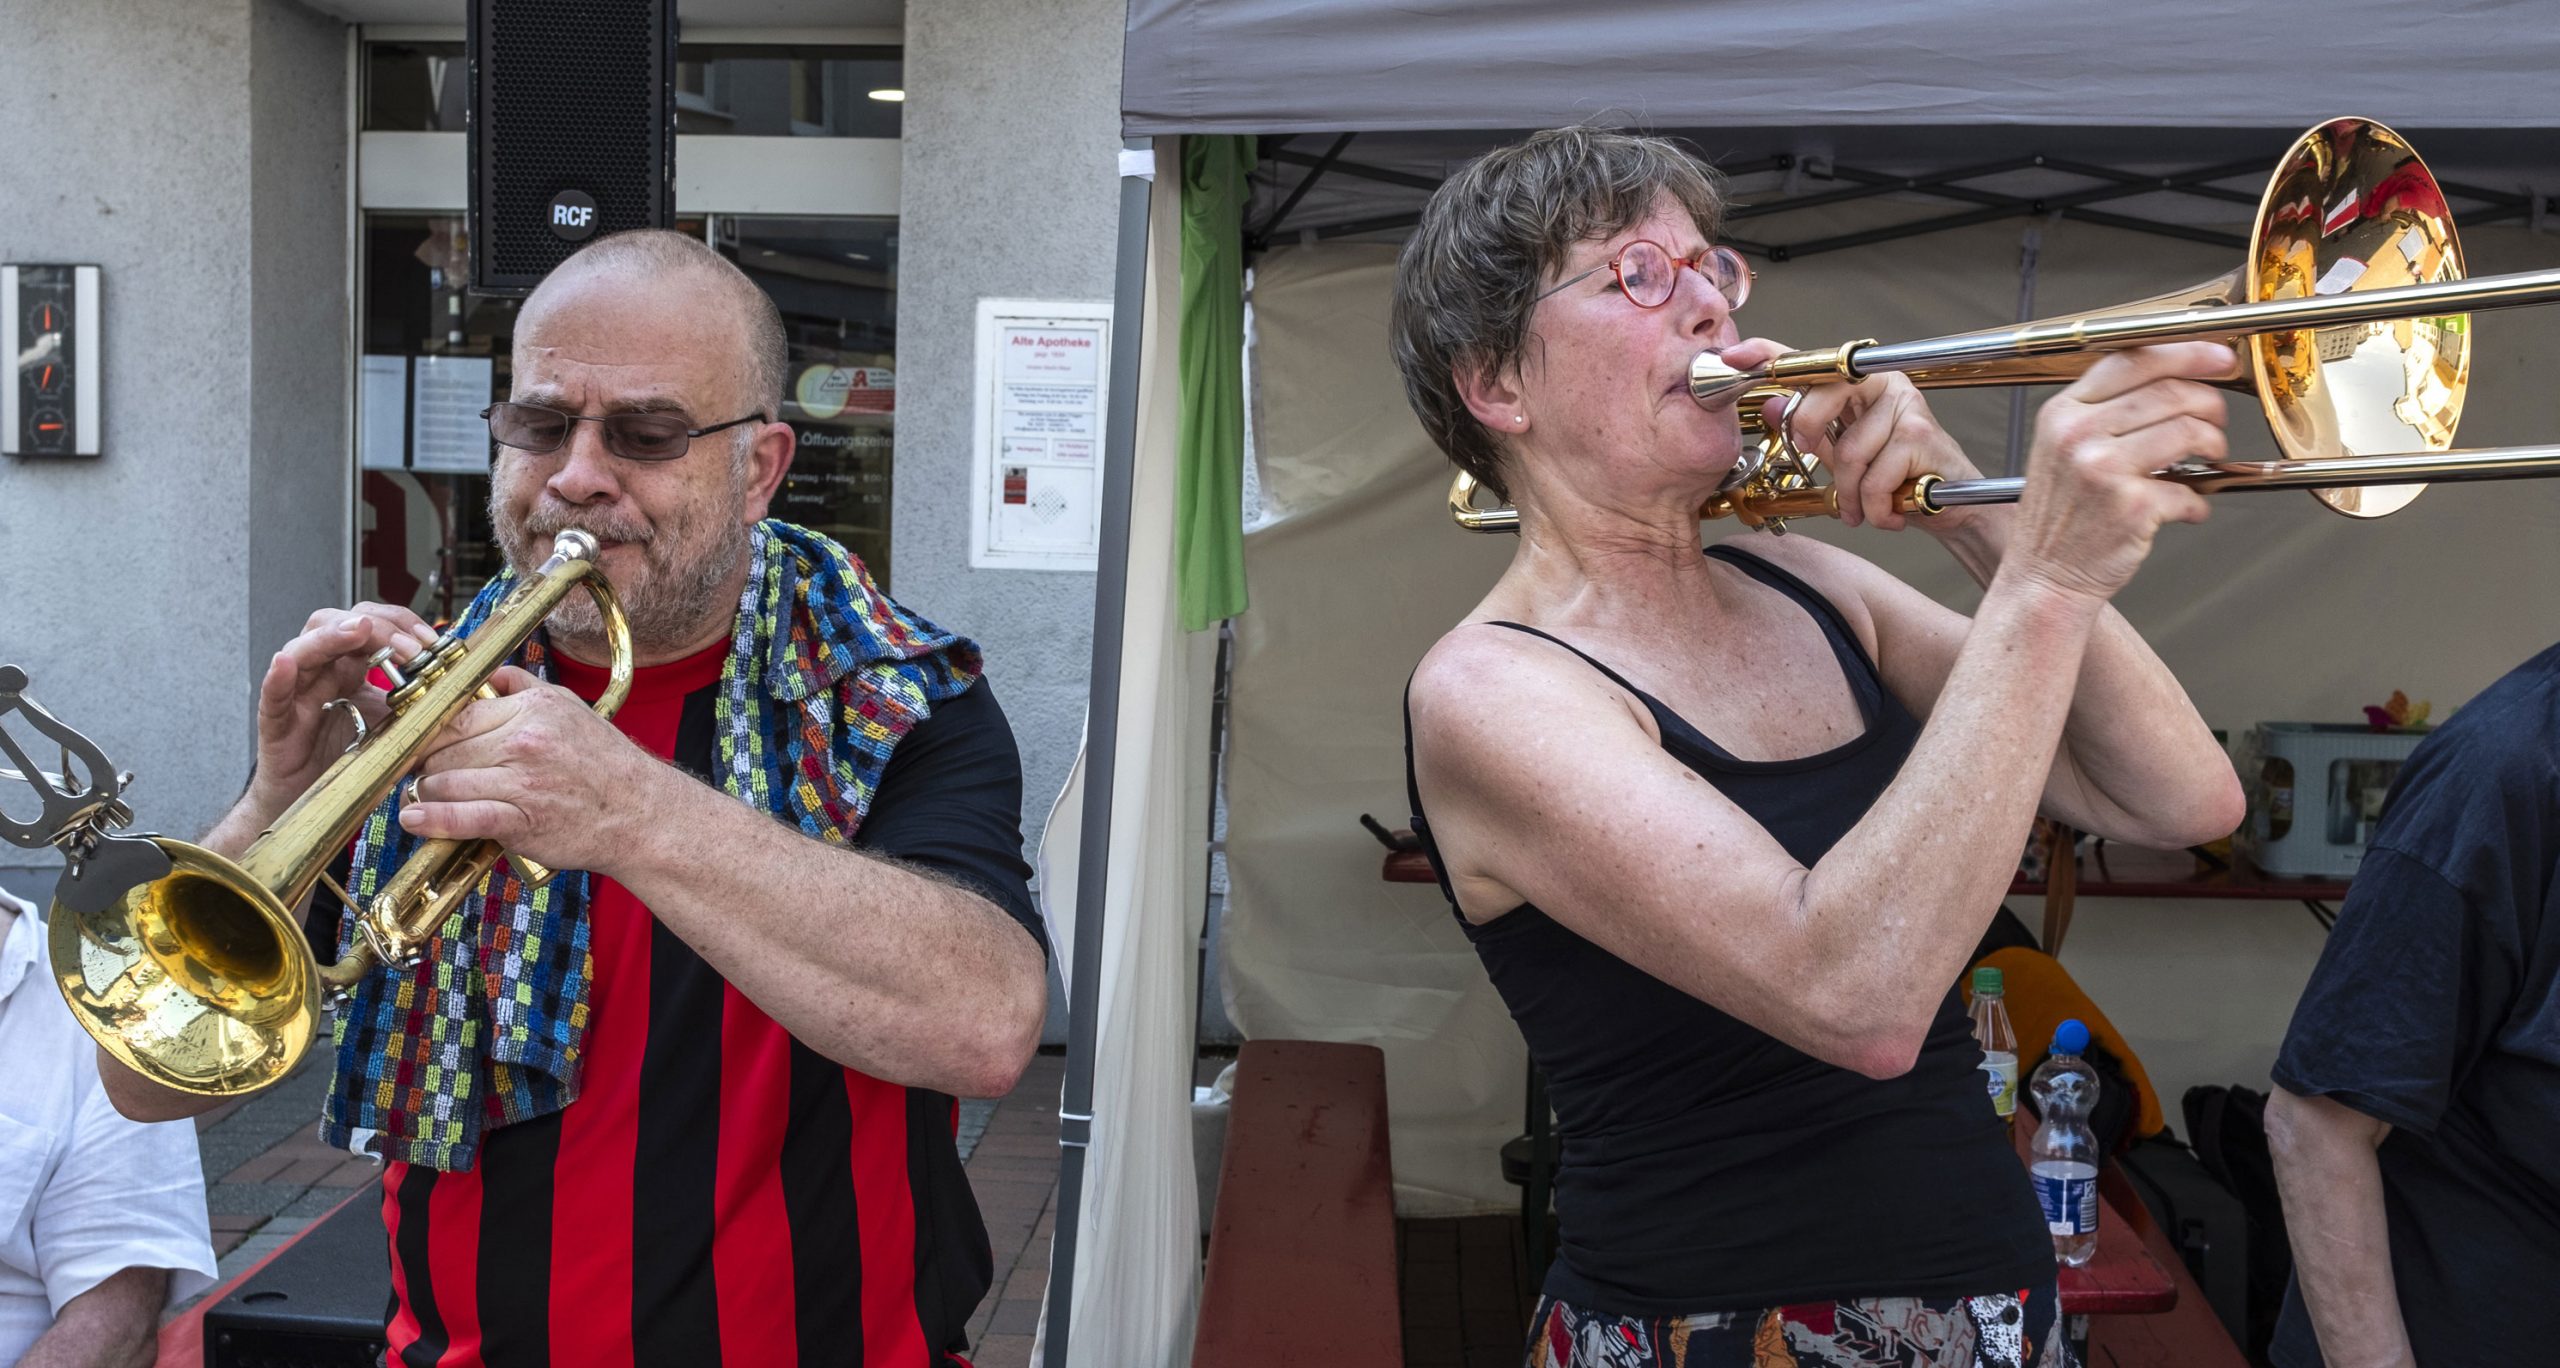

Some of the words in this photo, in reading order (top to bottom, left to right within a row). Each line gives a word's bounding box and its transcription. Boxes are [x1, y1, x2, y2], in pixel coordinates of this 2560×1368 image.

[553, 204, 593, 227] RCF
[1012, 336, 1034, 346] Alte
[1037, 336, 1091, 348] Apotheke
